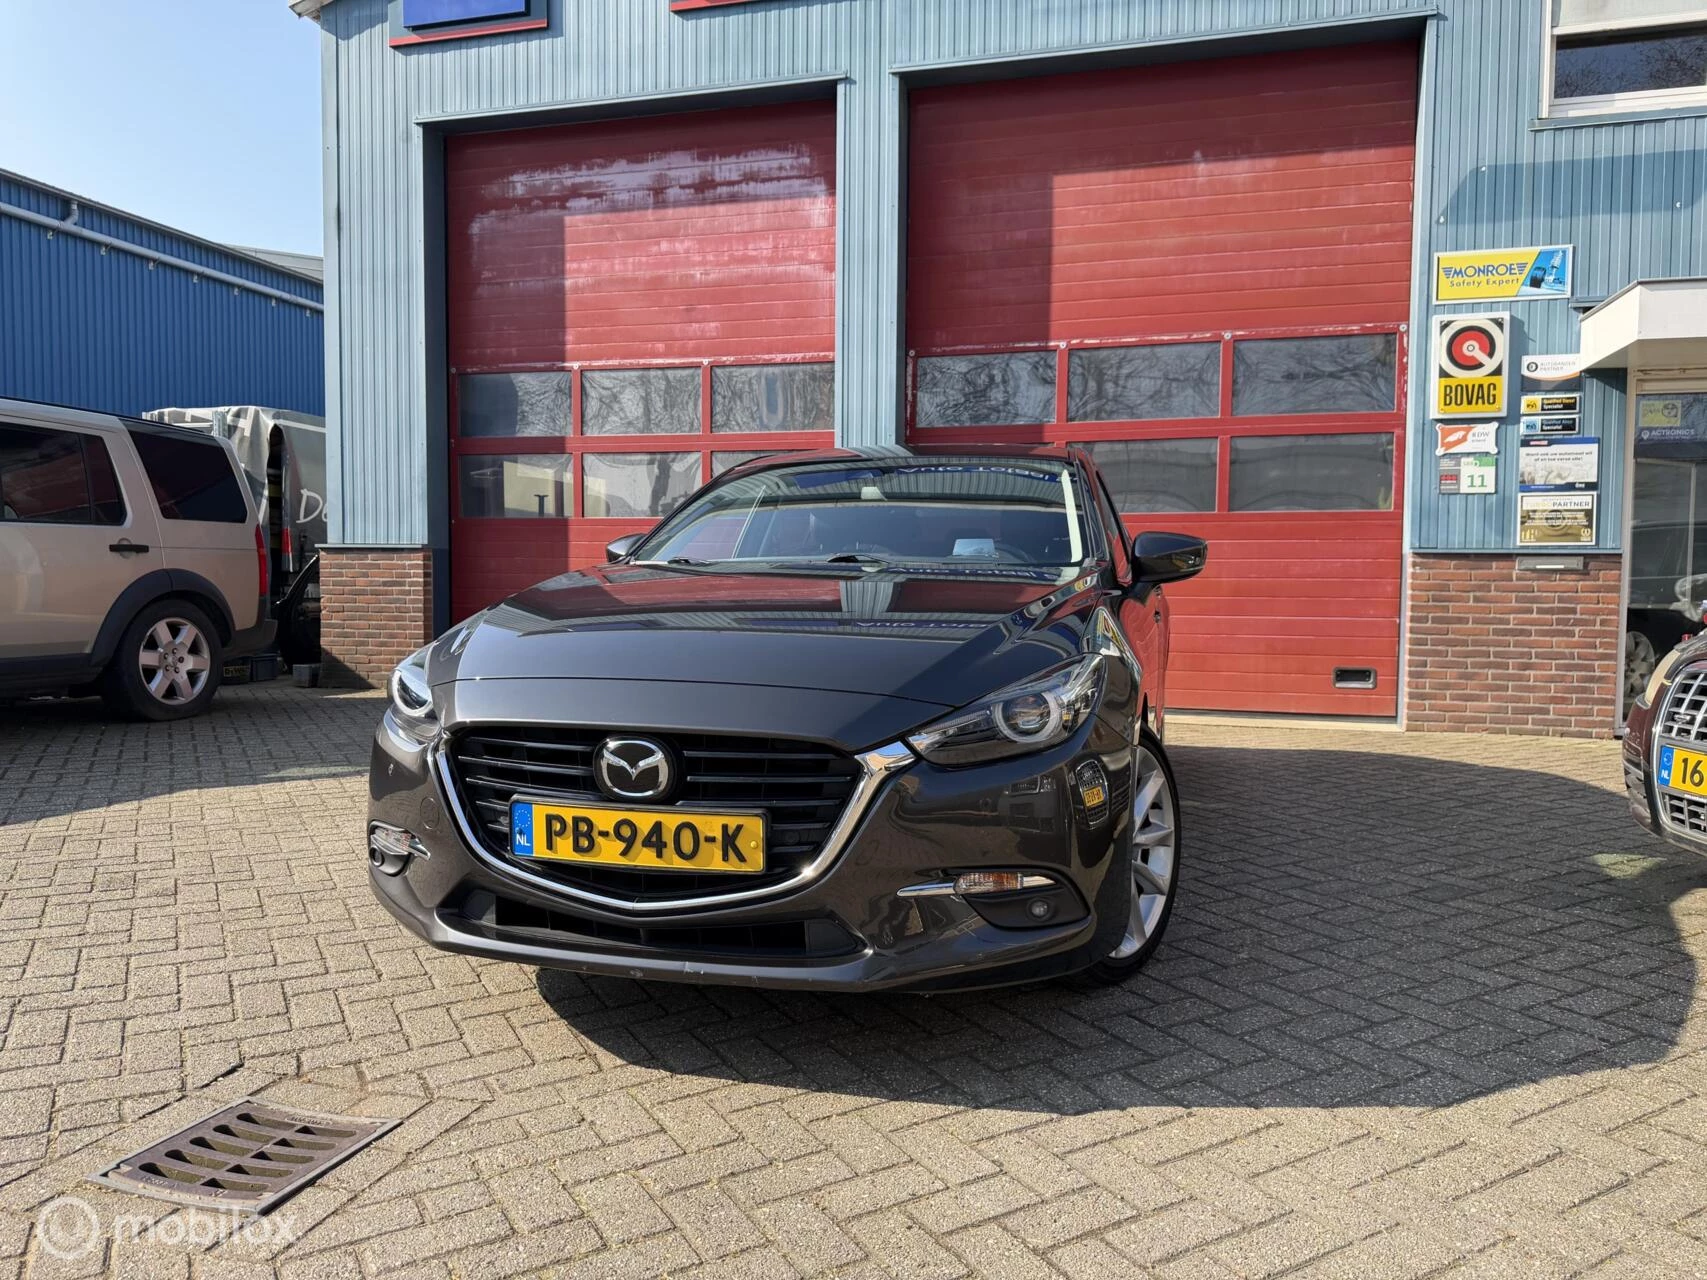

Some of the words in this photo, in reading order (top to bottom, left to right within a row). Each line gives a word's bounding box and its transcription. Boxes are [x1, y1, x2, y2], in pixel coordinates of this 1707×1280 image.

[1451, 263, 1517, 278] MONROE
[1449, 279, 1482, 288] Safety
[1486, 277, 1520, 287] Expert
[1443, 383, 1497, 406] BOVAG
[1467, 474, 1488, 488] 11
[1660, 769, 1670, 780] NL
[1682, 757, 1704, 787] 16
[516, 833, 531, 847] NL
[545, 813, 747, 863] PB-940-K
